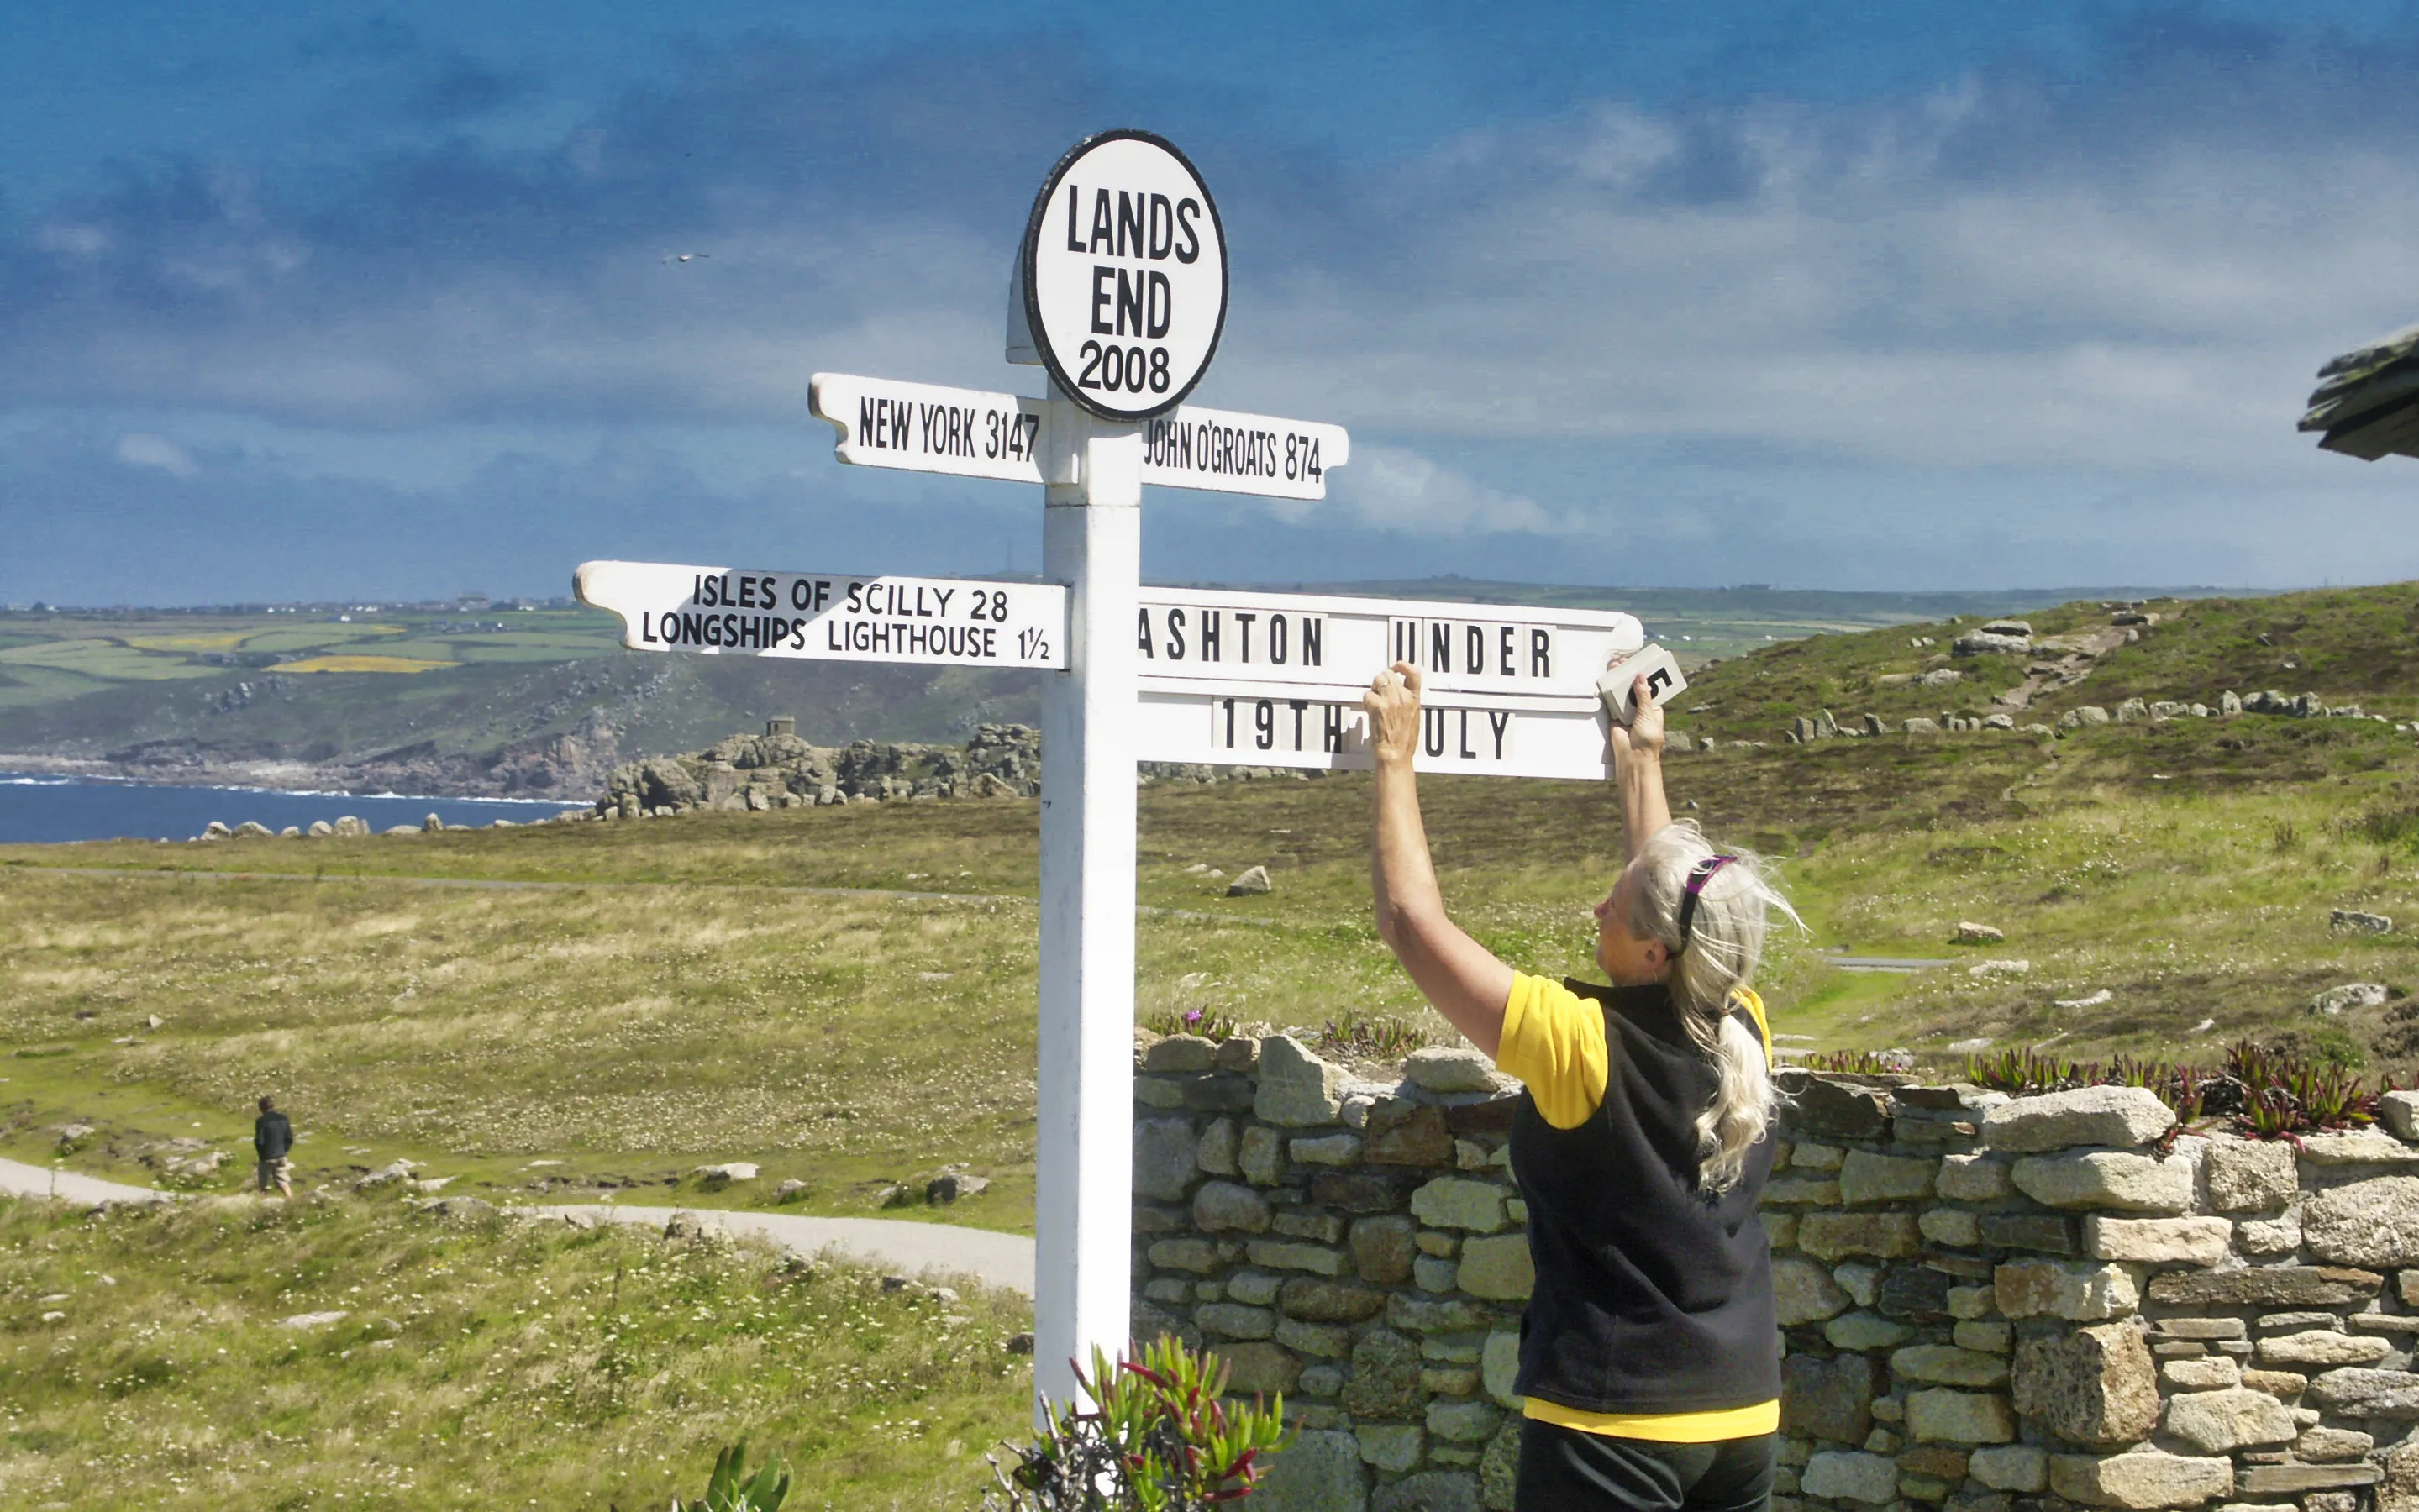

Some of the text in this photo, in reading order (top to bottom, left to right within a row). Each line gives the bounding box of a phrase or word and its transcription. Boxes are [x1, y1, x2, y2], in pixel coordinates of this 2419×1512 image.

[1067, 184, 1201, 265] LANDS
[1091, 265, 1172, 339] END
[1078, 339, 1170, 394] 2008
[859, 396, 1040, 462] NEW YORK 3147
[1144, 419, 1323, 484] JOHN O'GROATS 874
[692, 574, 1008, 623] ISLES OF SCILLY 28
[641, 611, 806, 650] LONGSHIPS
[828, 620, 997, 658] LIGHTHOUSE
[1138, 607, 1551, 679] ASHTON UNDER
[1223, 697, 1510, 760] 19TH ULY
